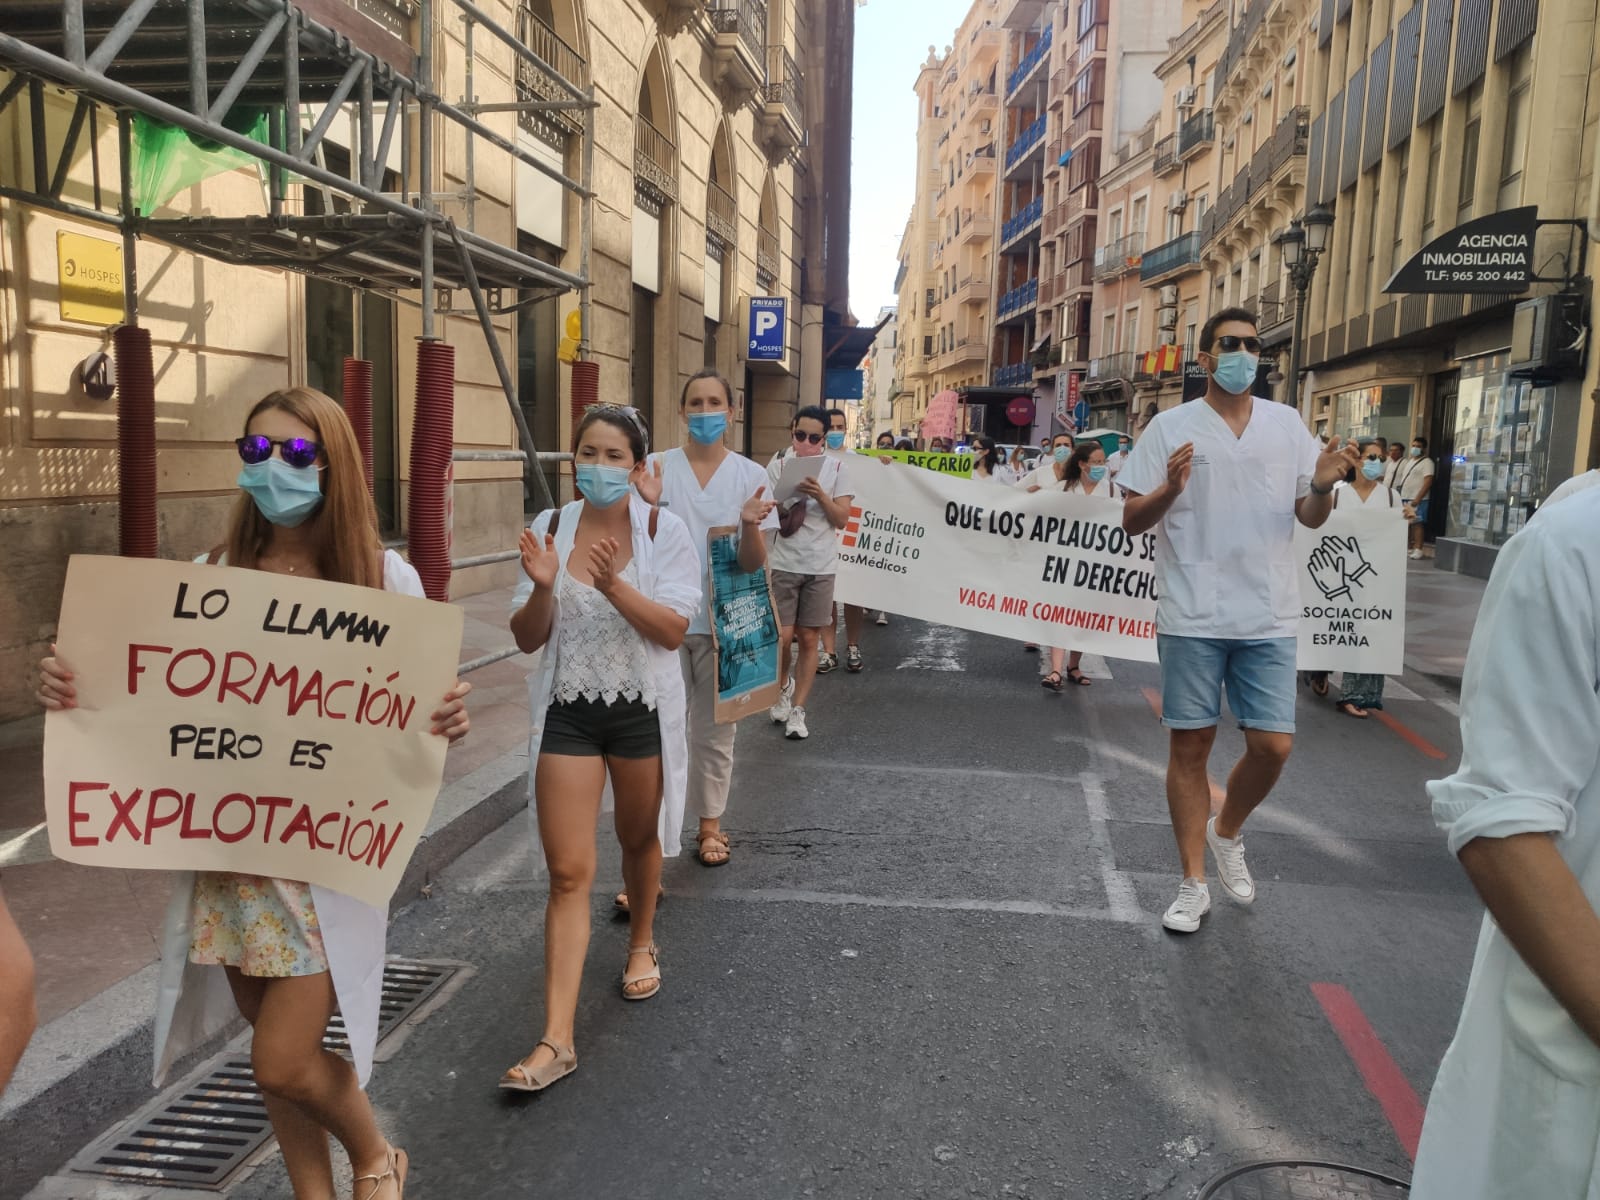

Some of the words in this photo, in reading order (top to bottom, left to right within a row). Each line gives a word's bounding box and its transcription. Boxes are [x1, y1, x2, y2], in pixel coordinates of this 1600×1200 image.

[1458, 234, 1528, 247] AGENCIA
[1422, 252, 1526, 265] INMOBILIARIA
[80, 267, 120, 285] HOSPES
[1424, 270, 1449, 281] TLF:
[1452, 271, 1473, 281] 965
[1476, 271, 1500, 281] 200
[1503, 271, 1525, 281] 442
[755, 311, 778, 336] P
[863, 510, 925, 538] Sindicato
[945, 501, 983, 531] QUE
[989, 510, 1025, 539] LOS
[1030, 515, 1134, 557] APLAUSOS
[857, 532, 920, 560] Médico
[1042, 555, 1070, 584] EN
[173, 582, 229, 619] LO
[959, 587, 996, 610] VAGA
[1000, 596, 1029, 617] MIR
[1032, 602, 1115, 632] COMUNITAT
[262, 598, 390, 647] LLAMAN
[1328, 621, 1355, 632] MIR
[1312, 632, 1370, 647] ESPAÑA
[128, 643, 416, 730] FORMACIÓN
[169, 724, 262, 760] PERO
[289, 739, 333, 770] ES
[68, 781, 404, 869] EXPLOTACIÓN
